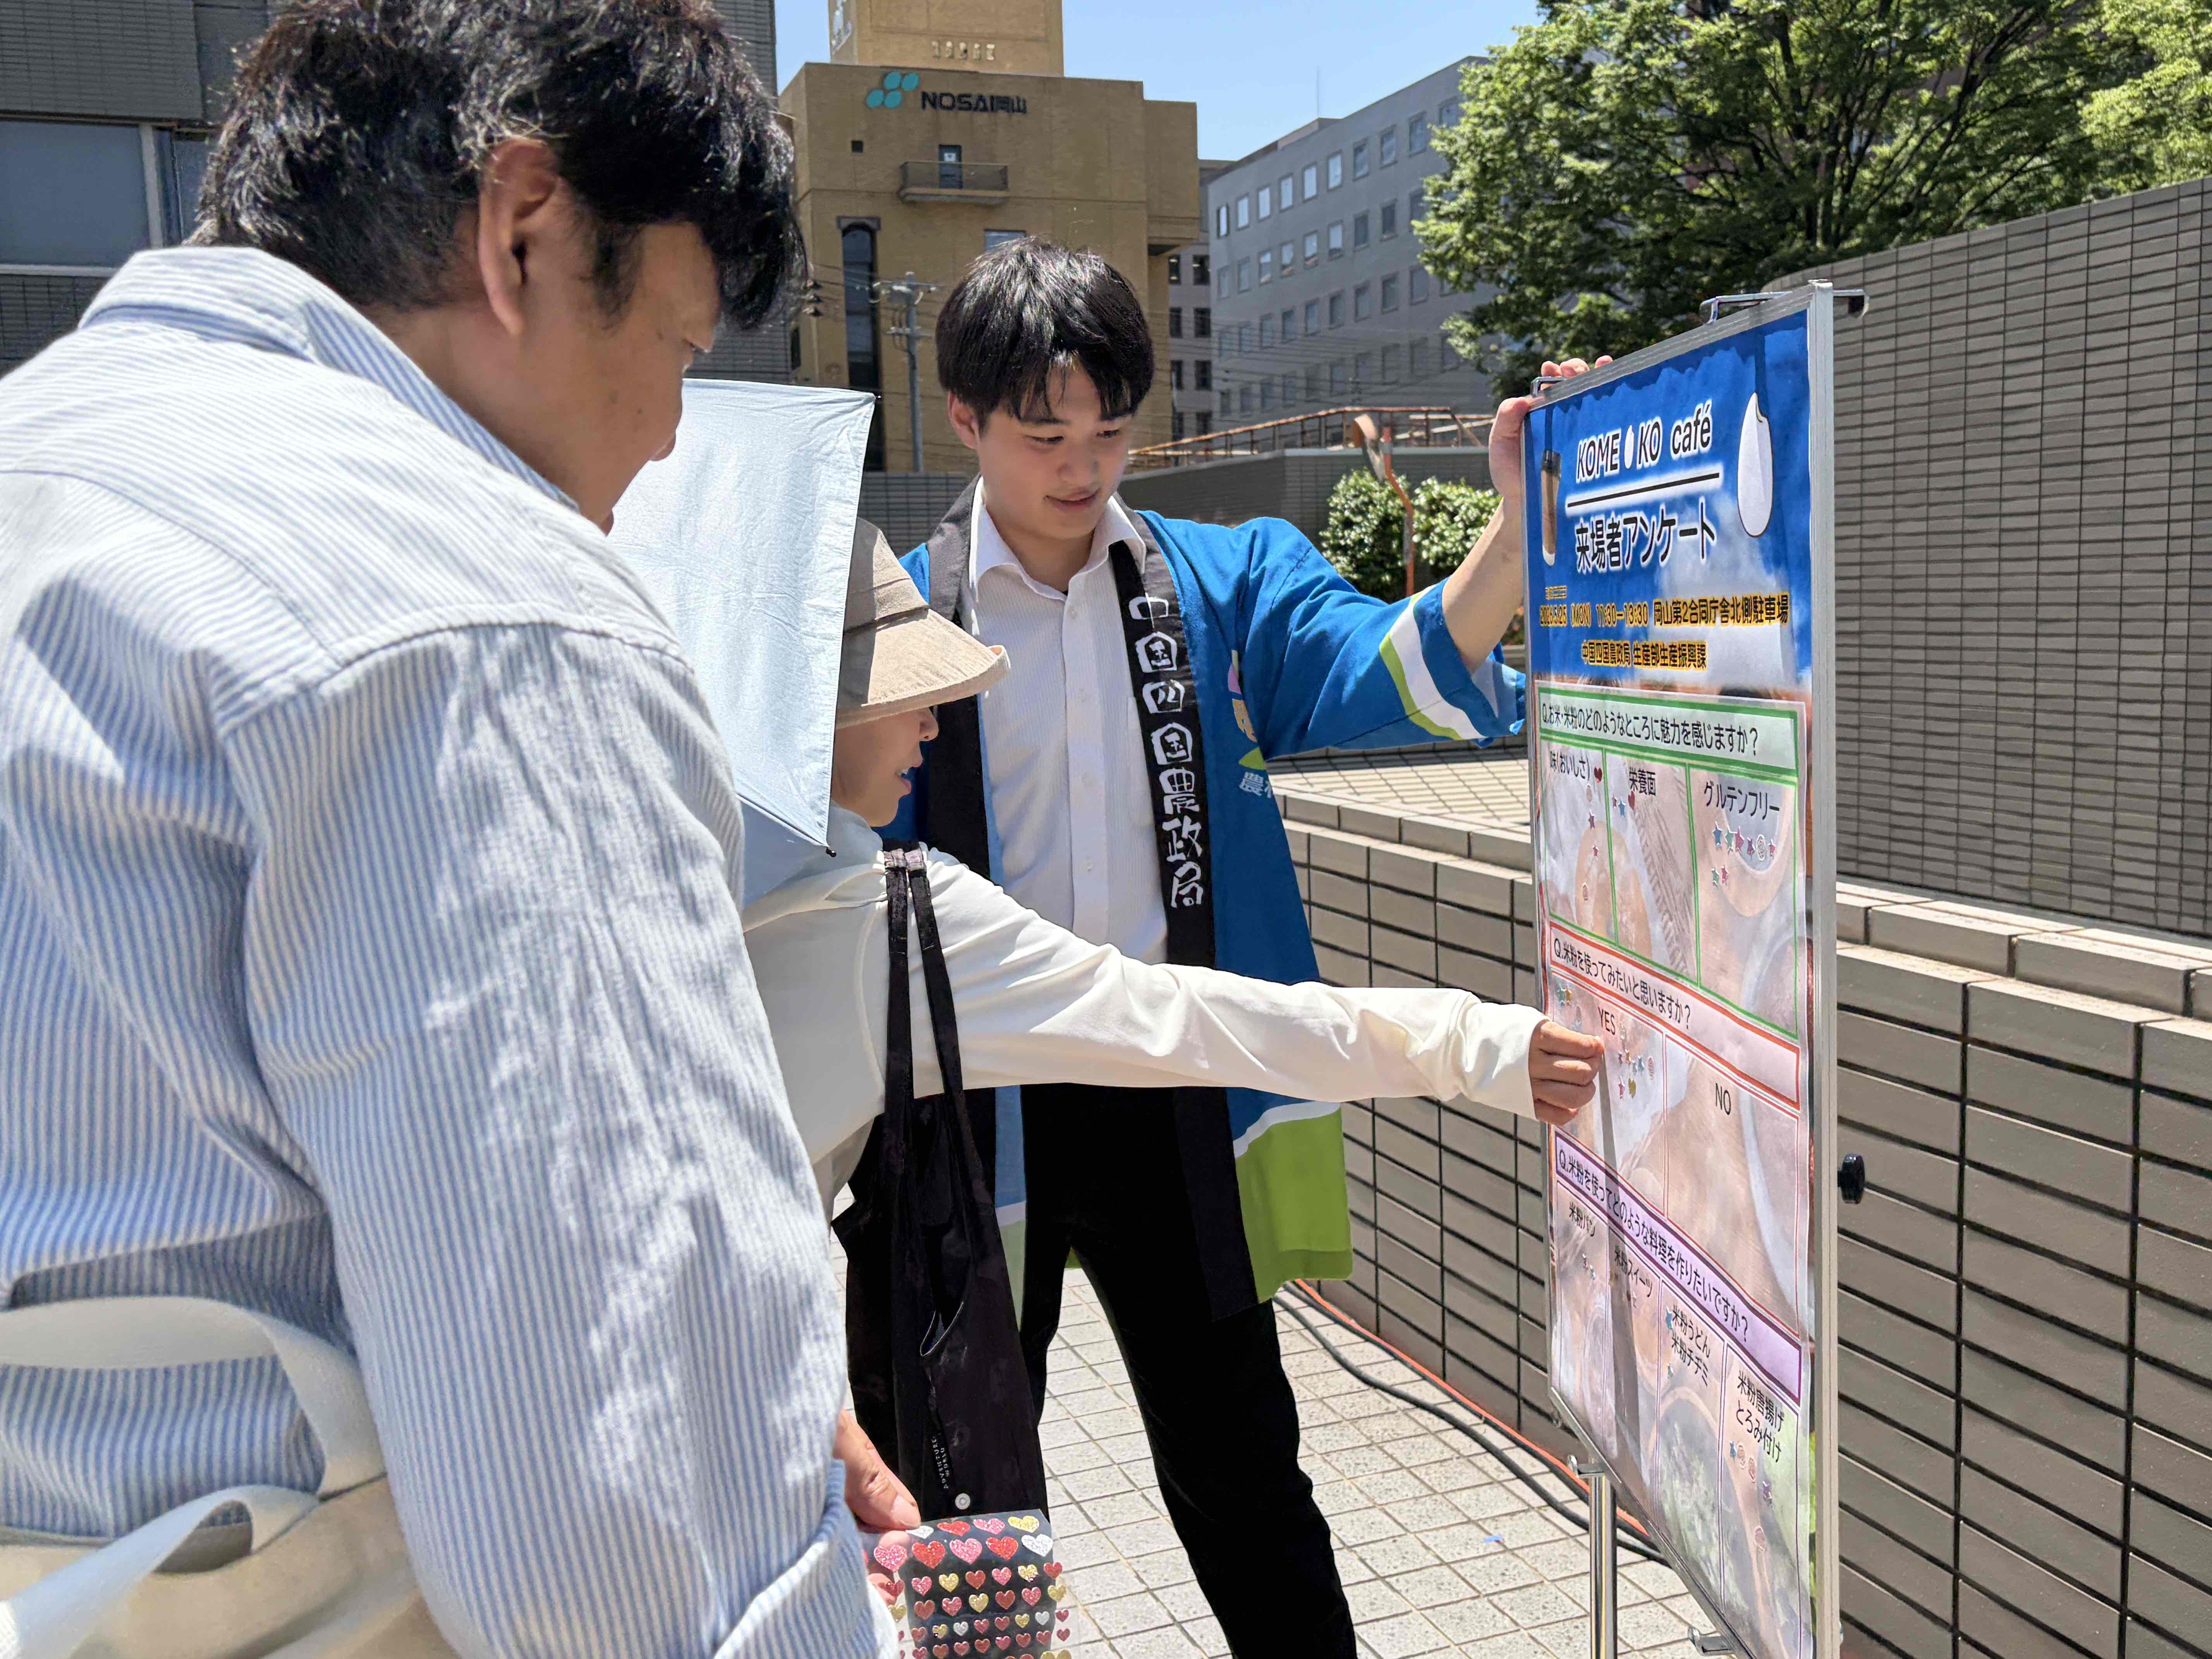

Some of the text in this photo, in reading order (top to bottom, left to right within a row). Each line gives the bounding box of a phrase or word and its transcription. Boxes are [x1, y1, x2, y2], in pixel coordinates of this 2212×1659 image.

[1577, 404, 1711, 479] KOME KO café
[1576, 501, 1715, 570] 来場者アンケート
[1128, 593, 1204, 908] 中国四国農政局
[1629, 768, 1656, 796] 栄養面
[1704, 781, 1780, 820] グルテンフリー
[1598, 1007, 1616, 1036] YES
[1716, 1083, 1731, 1115] NO
[1569, 1202, 1595, 1236] 米粉パン
[1615, 1245, 1653, 1297] 米粉スイーツ
[1673, 1305, 1710, 1358] 米粉うどん
[1671, 1332, 1708, 1387] 米粉チヂミ
[1737, 1370, 1784, 1432] 米粉唐揚げ
[1736, 1400, 1782, 1462] とろみ付け
